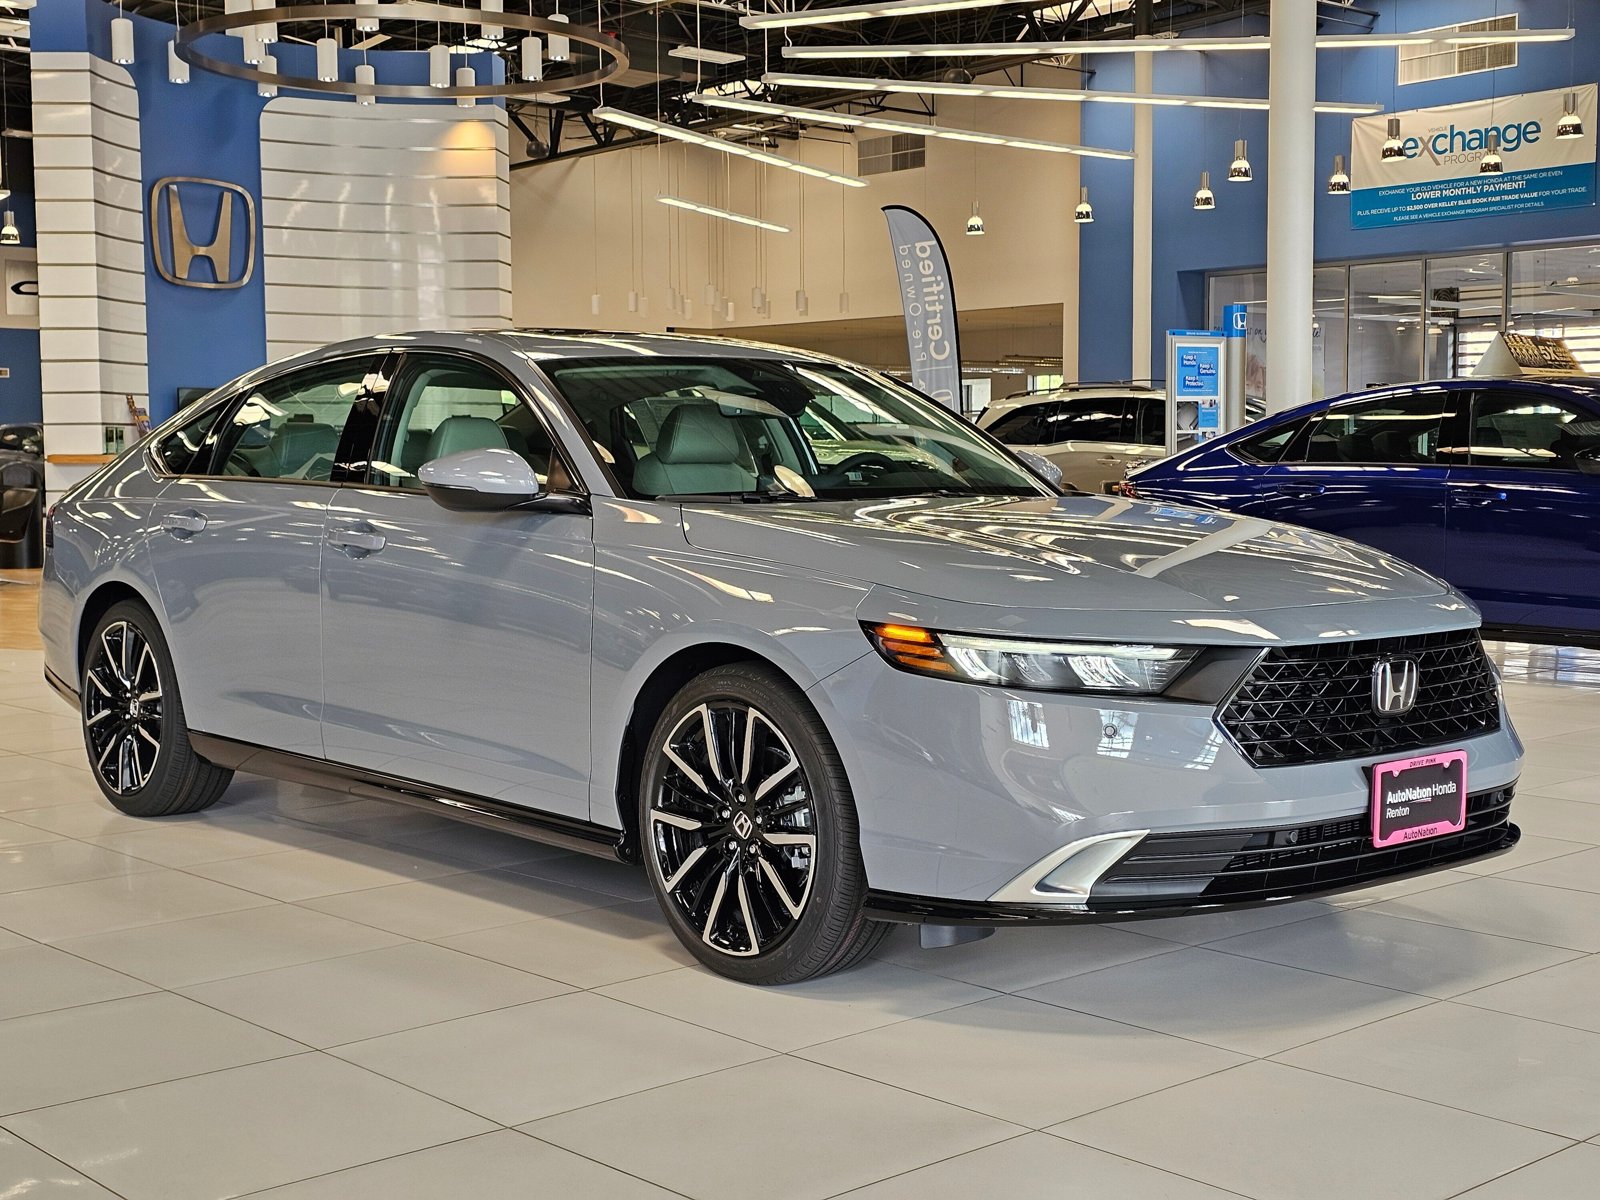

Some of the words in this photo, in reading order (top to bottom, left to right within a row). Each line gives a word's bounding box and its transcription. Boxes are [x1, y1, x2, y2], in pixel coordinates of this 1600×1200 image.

[1402, 120, 1542, 166] exchange
[1379, 188, 1405, 196] EXCHANGE
[1548, 170, 1563, 178] EVEN
[1412, 190, 1440, 200] LOWER
[1442, 185, 1482, 197] MONTHLY
[1483, 181, 1526, 193] PAYMENT!
[1438, 200, 1458, 208] KELLEY
[1551, 188, 1567, 196] YOUR
[1568, 186, 1587, 194] TRADE.
[1489, 204, 1514, 212] SPECIALIST
[1409, 760, 1423, 768] DRIVE
[1425, 758, 1436, 766] PINK
[1386, 786, 1432, 804] AutoNation
[1432, 781, 1457, 796] Honda
[1386, 806, 1410, 819] Renton
[1403, 827, 1438, 840] AutoNation
